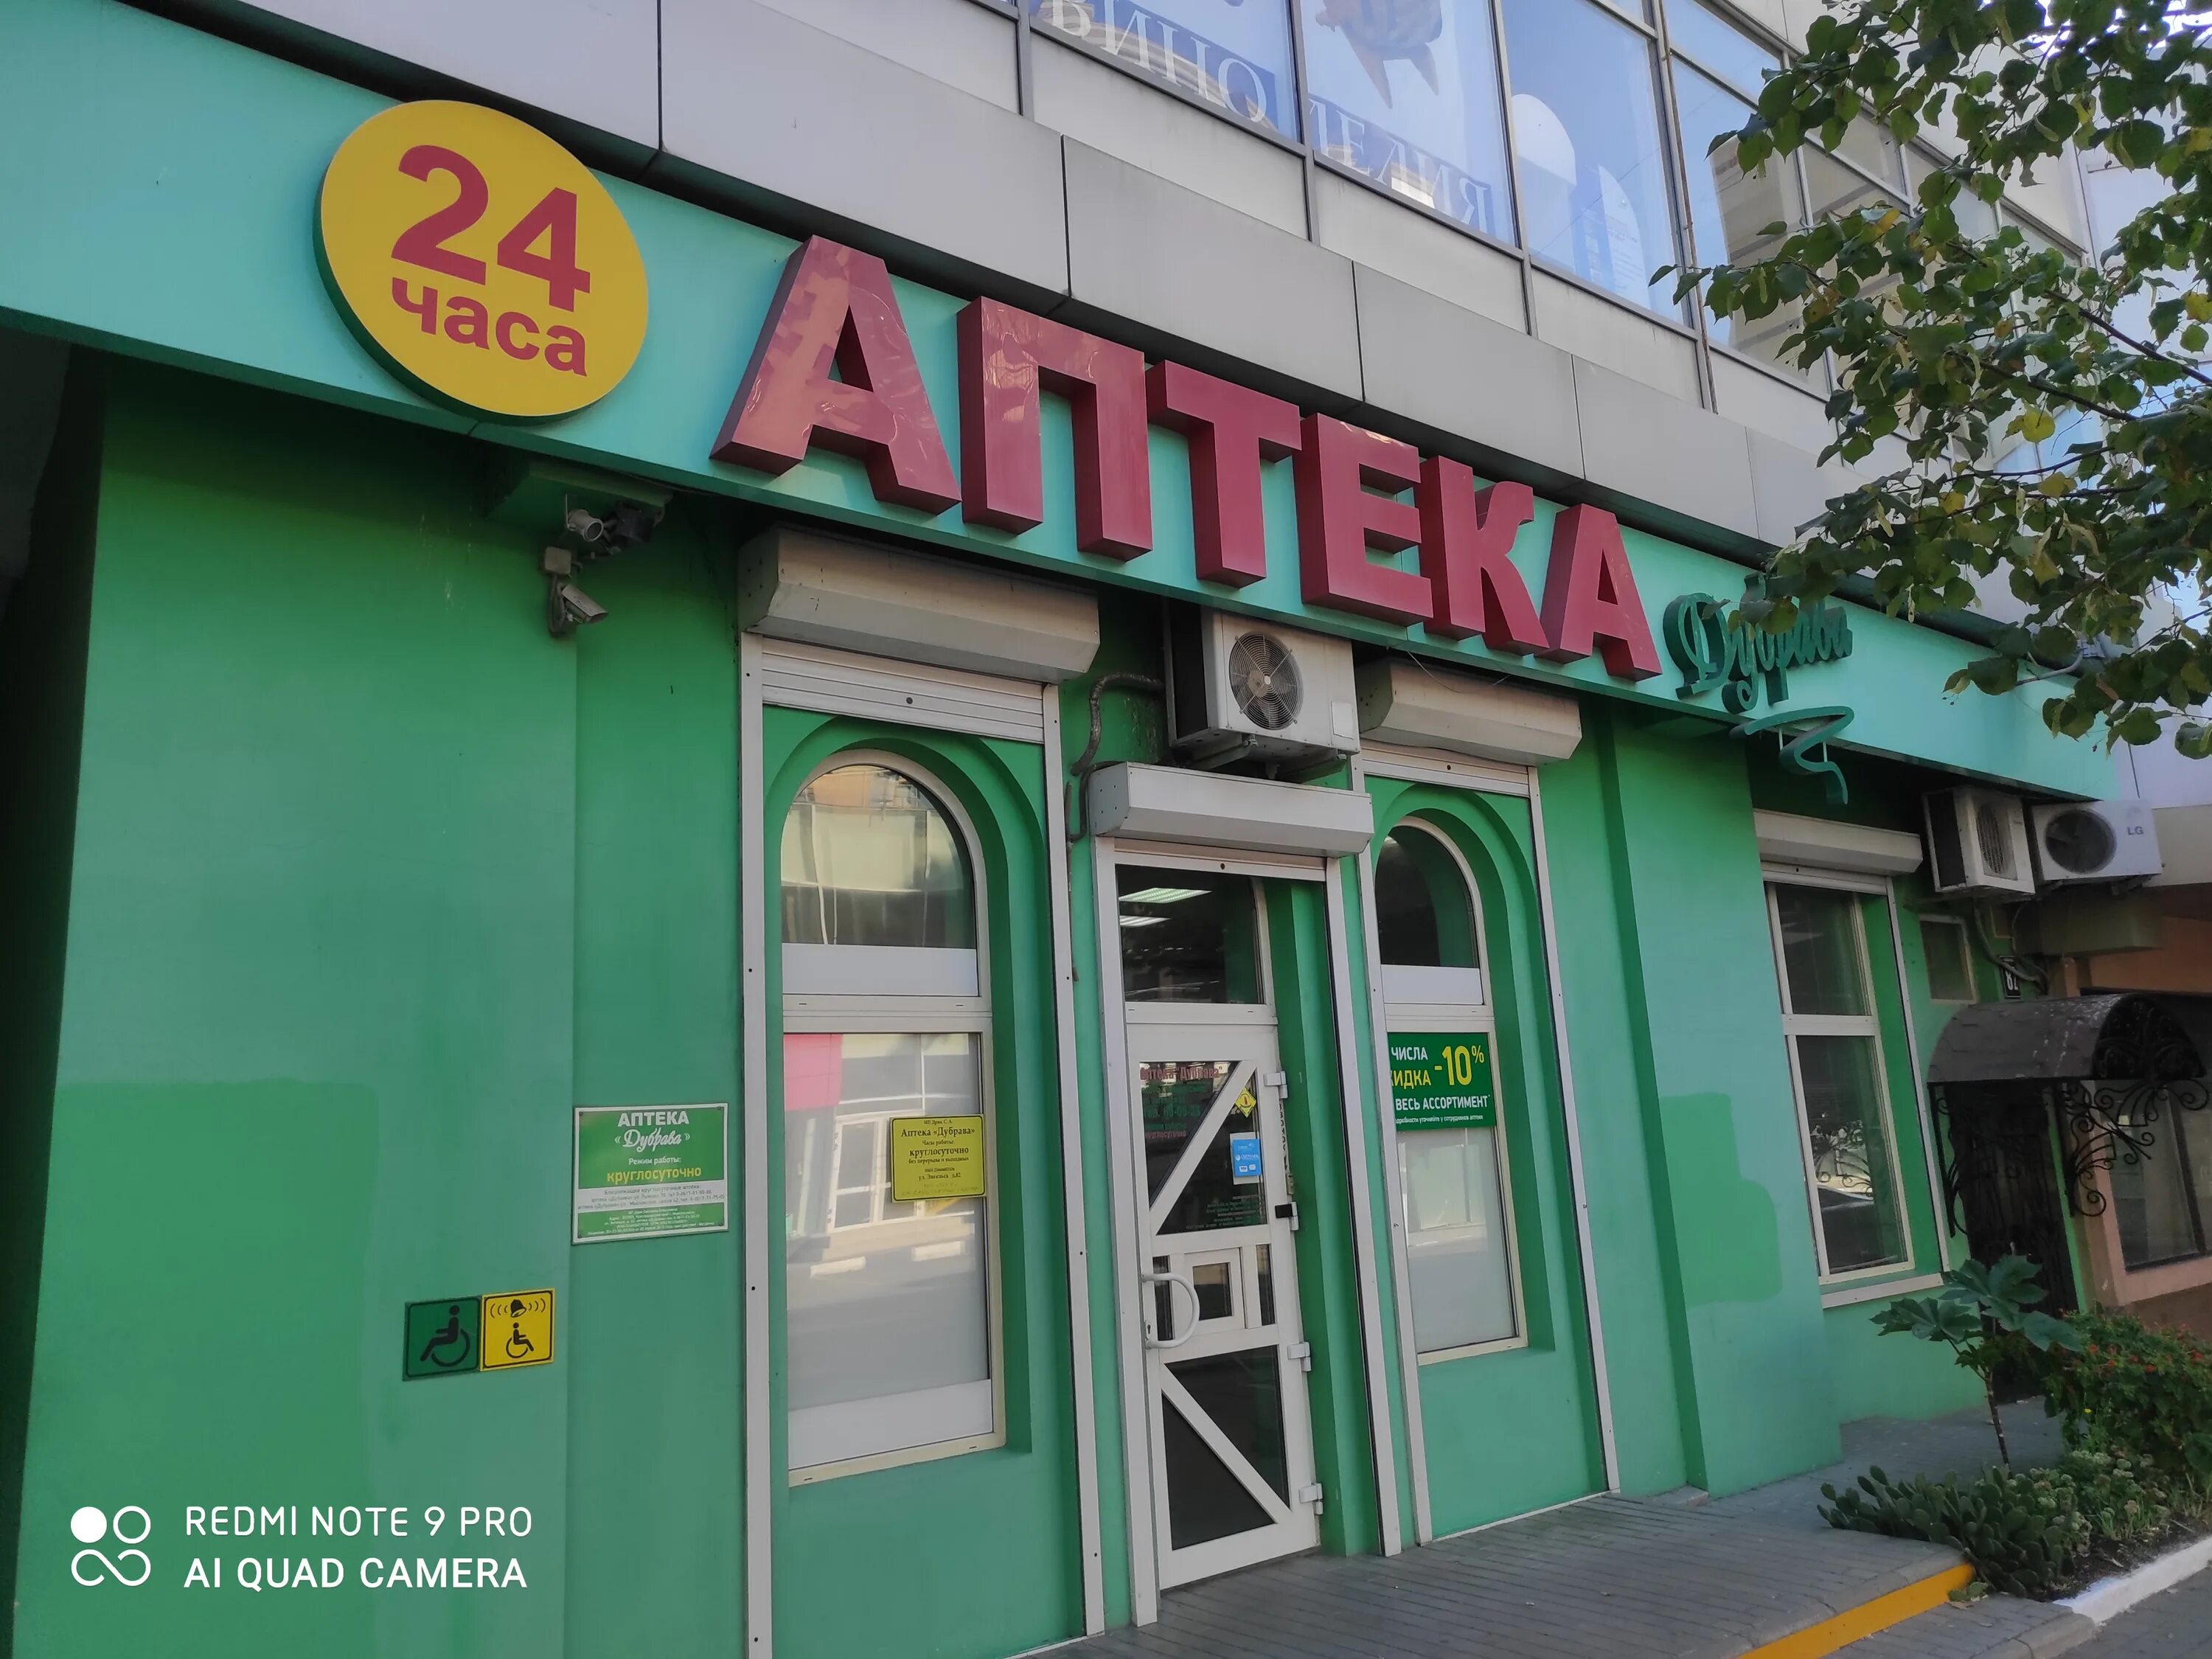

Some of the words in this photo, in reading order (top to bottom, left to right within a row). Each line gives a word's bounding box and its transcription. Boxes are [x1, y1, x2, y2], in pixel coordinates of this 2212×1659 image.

[392, 145, 591, 313] 24
[392, 277, 587, 377] часа
[709, 234, 1663, 682] АПТЕКА
[2127, 826, 2144, 835] LG
[1391, 1046, 1428, 1060] ЧИСЛА
[1395, 1098, 1420, 1111] ВЕСЬ
[617, 1110, 689, 1127] АПТЕКА
[900, 1128, 931, 1138] Аптека
[933, 1127, 975, 1138] «Дубрава»
[909, 1147, 969, 1158] круглосуточно
[628, 1157, 653, 1166] Режим
[653, 1155, 682, 1166] работы:
[607, 1166, 702, 1186] круглосуточно
